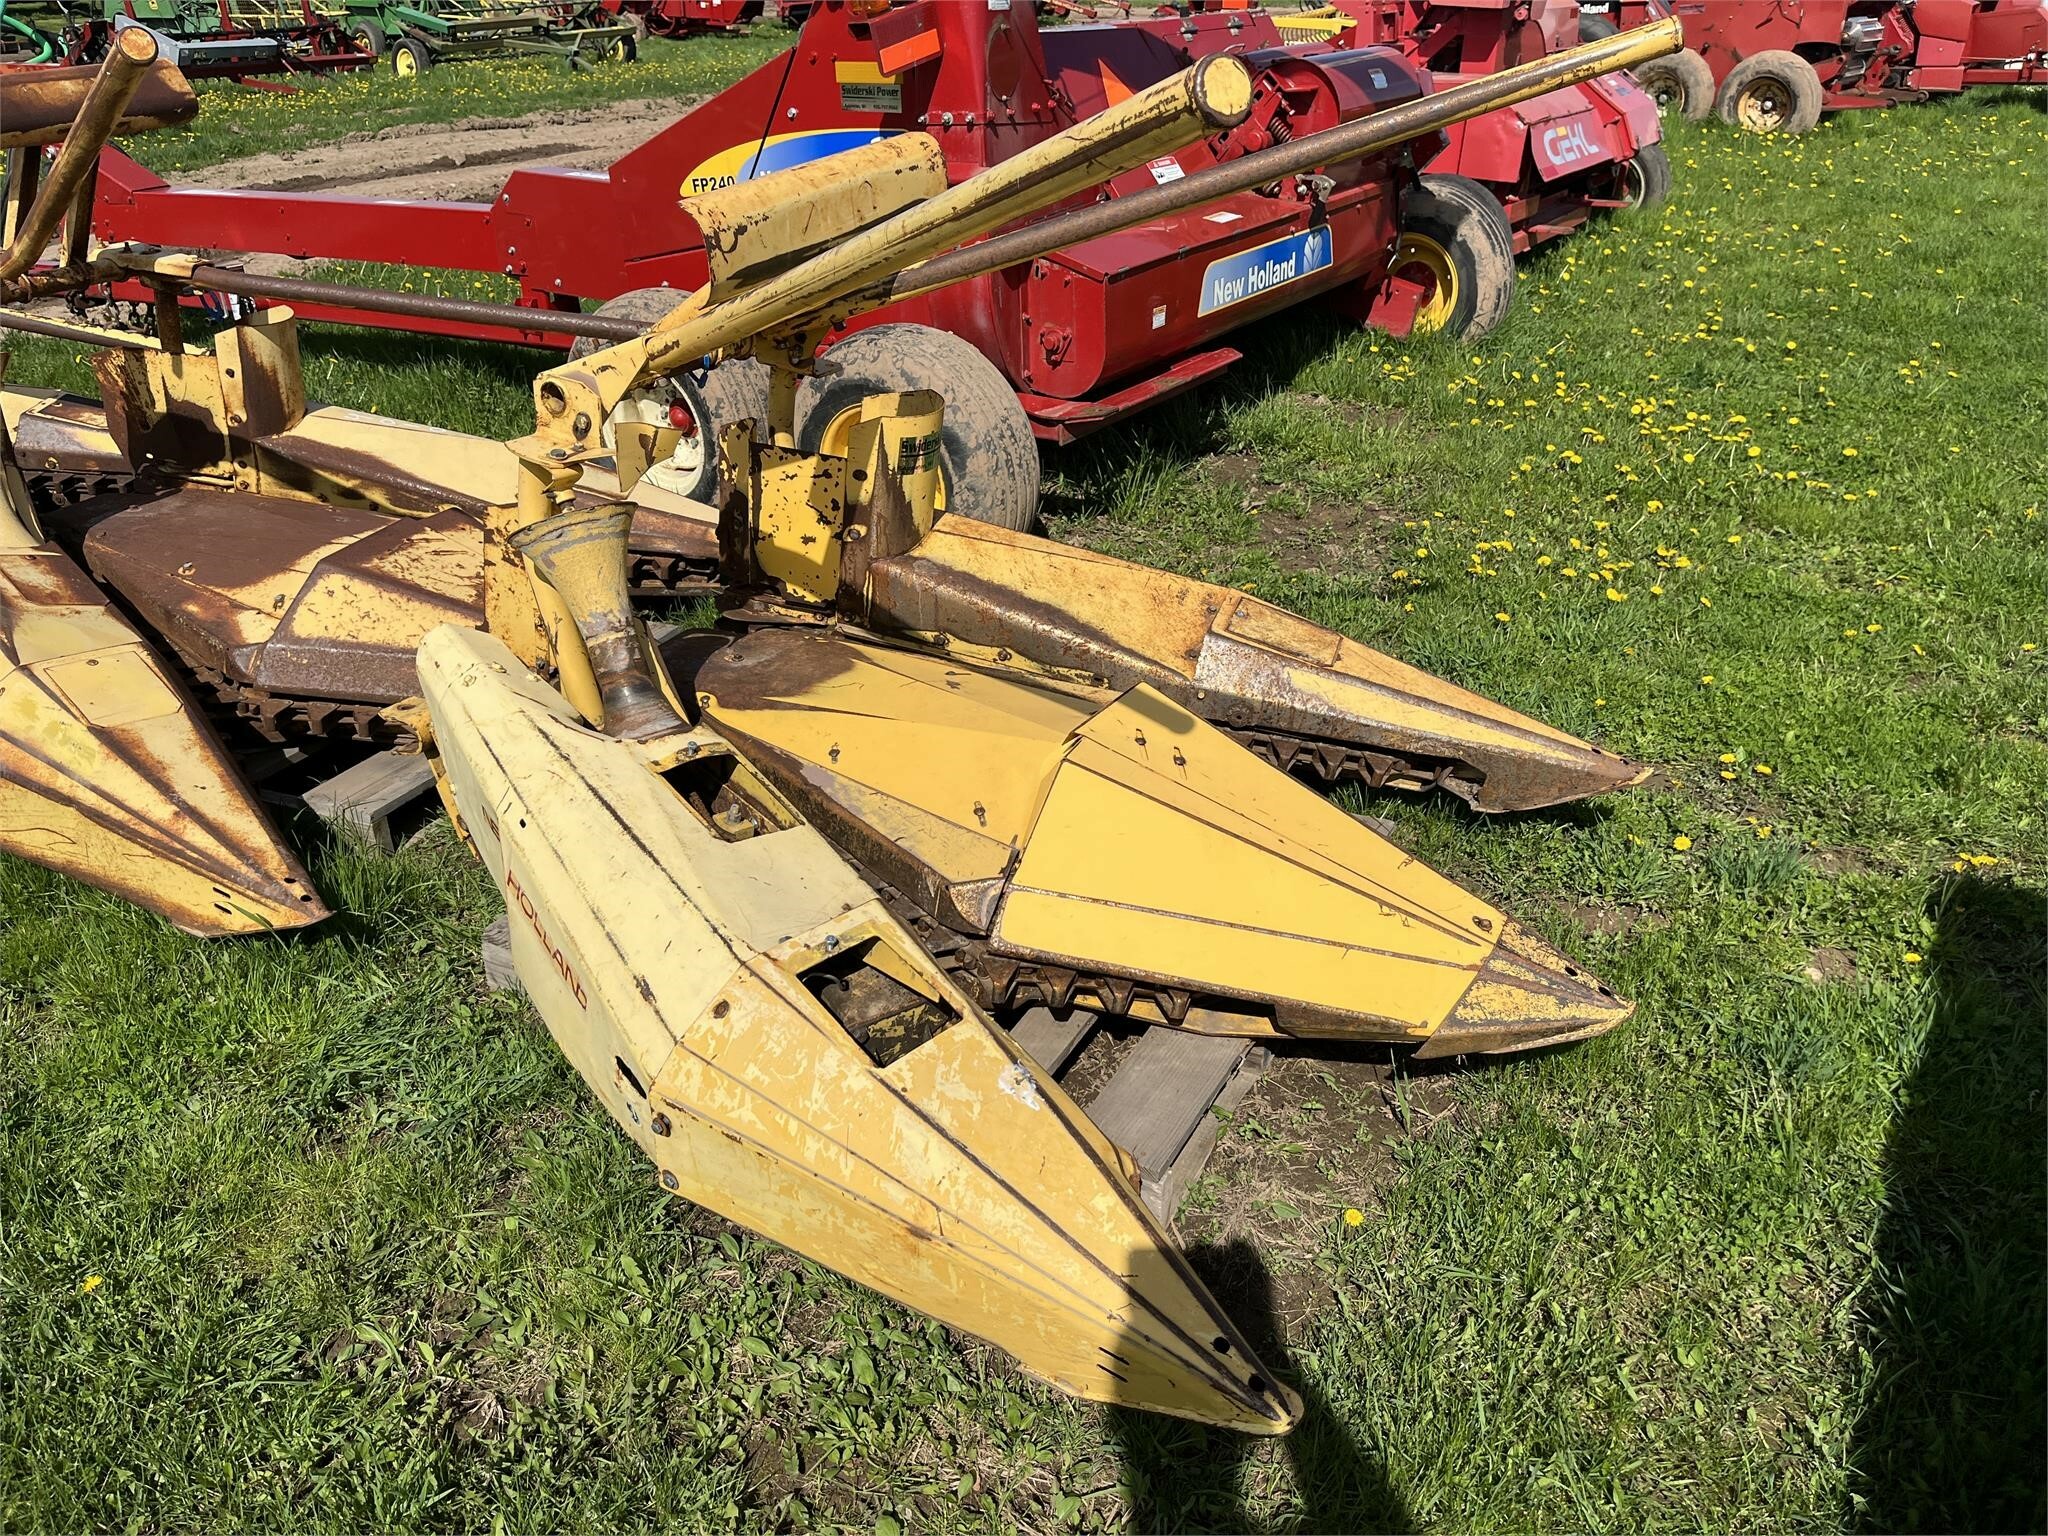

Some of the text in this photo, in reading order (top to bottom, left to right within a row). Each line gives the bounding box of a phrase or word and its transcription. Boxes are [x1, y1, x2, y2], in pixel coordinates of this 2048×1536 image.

[842, 85, 899, 97] Swiderski Power
[1543, 121, 1600, 166] GEHL
[692, 175, 736, 193] FP240
[1213, 252, 1296, 307] New Holland
[506, 869, 588, 1011] HOLLAND
